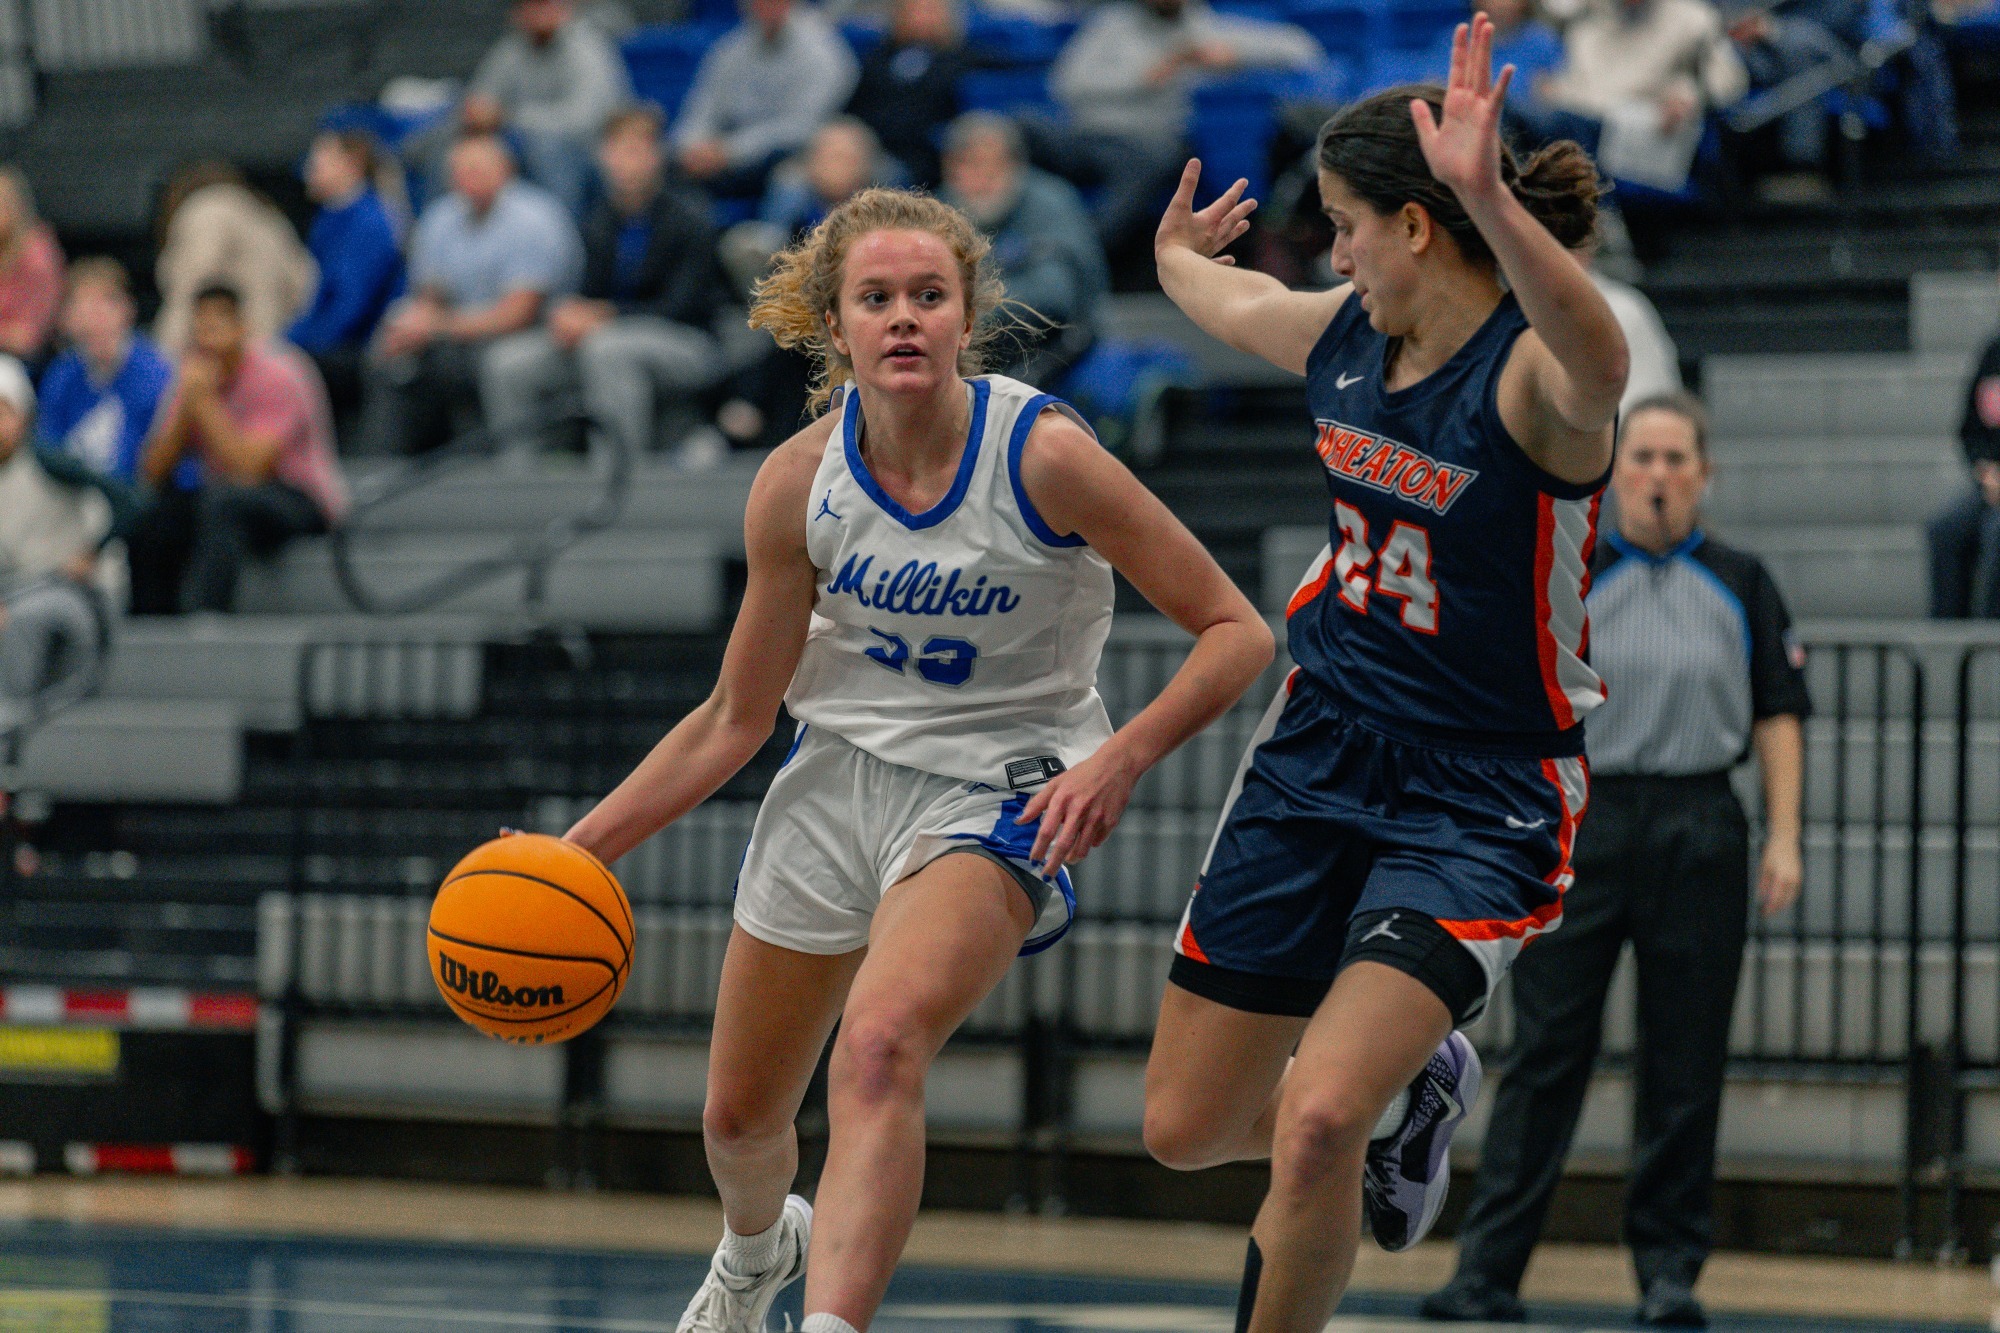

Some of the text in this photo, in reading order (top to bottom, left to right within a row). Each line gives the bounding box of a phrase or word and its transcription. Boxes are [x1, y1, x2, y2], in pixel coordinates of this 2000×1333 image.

[1315, 419, 1477, 514] WHEATON
[827, 553, 1020, 616] Millikin
[1333, 498, 1439, 636] 24
[1047, 761, 1059, 772] L
[439, 950, 565, 1008] Wilson
